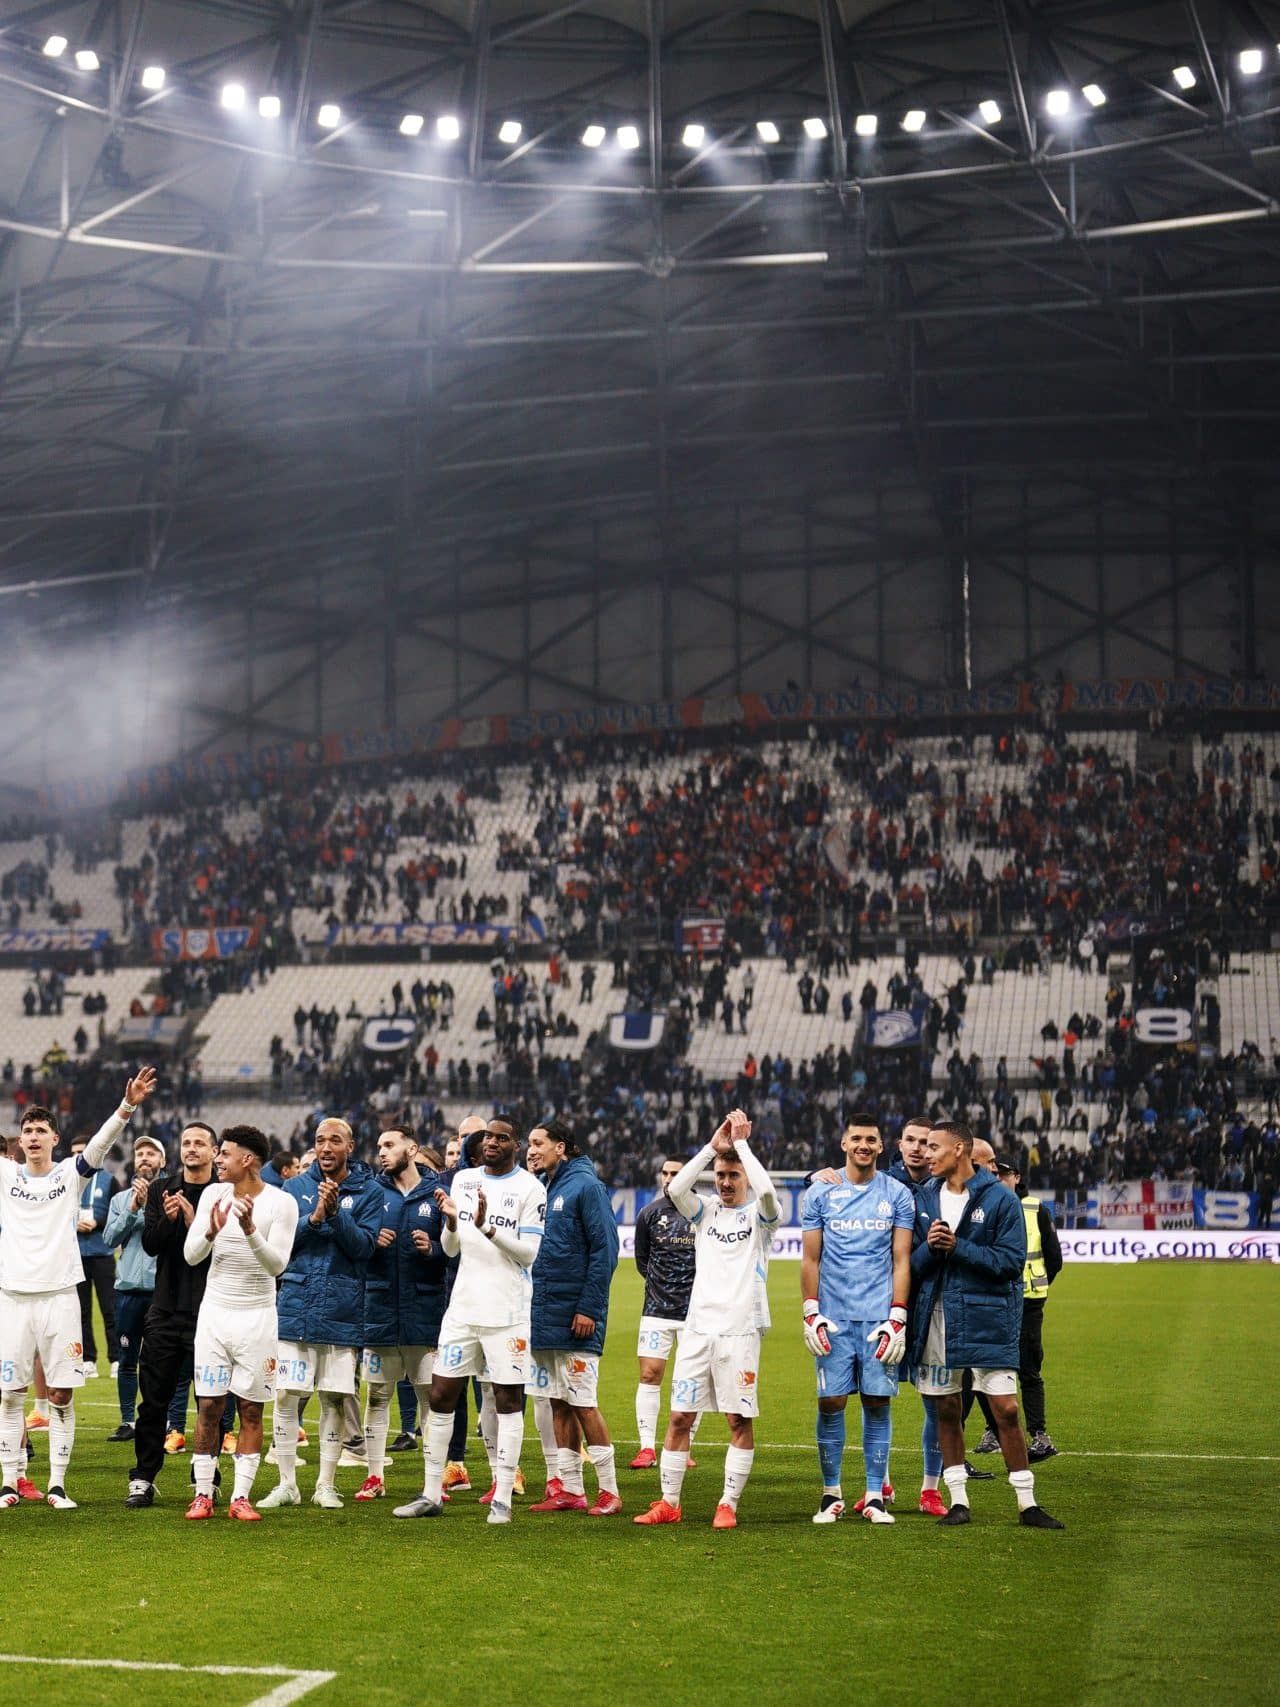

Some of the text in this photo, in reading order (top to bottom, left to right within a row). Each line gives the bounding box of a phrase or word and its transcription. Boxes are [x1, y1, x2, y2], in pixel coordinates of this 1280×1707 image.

[763, 689, 1018, 717] WINNERS
[1074, 680, 1280, 706] MARSE
[363, 1019, 416, 1051] C
[609, 1015, 665, 1049] U
[1134, 1008, 1193, 1043] 8
[41, 1185, 66, 1202] GM
[830, 1219, 894, 1231] CMA CGM
[1161, 1218, 1193, 1230] WHU
[669, 1235, 696, 1246] randst
[1060, 1238, 1216, 1260] ecrute.com
[649, 1331, 660, 1350] 8
[370, 1353, 381, 1374] 9
[442, 1344, 463, 1367] 19
[1, 1360, 14, 1383] 5
[202, 1365, 229, 1387] 44
[291, 1360, 307, 1382] 13
[930, 1364, 950, 1387] 10
[676, 1380, 698, 1405] 21
